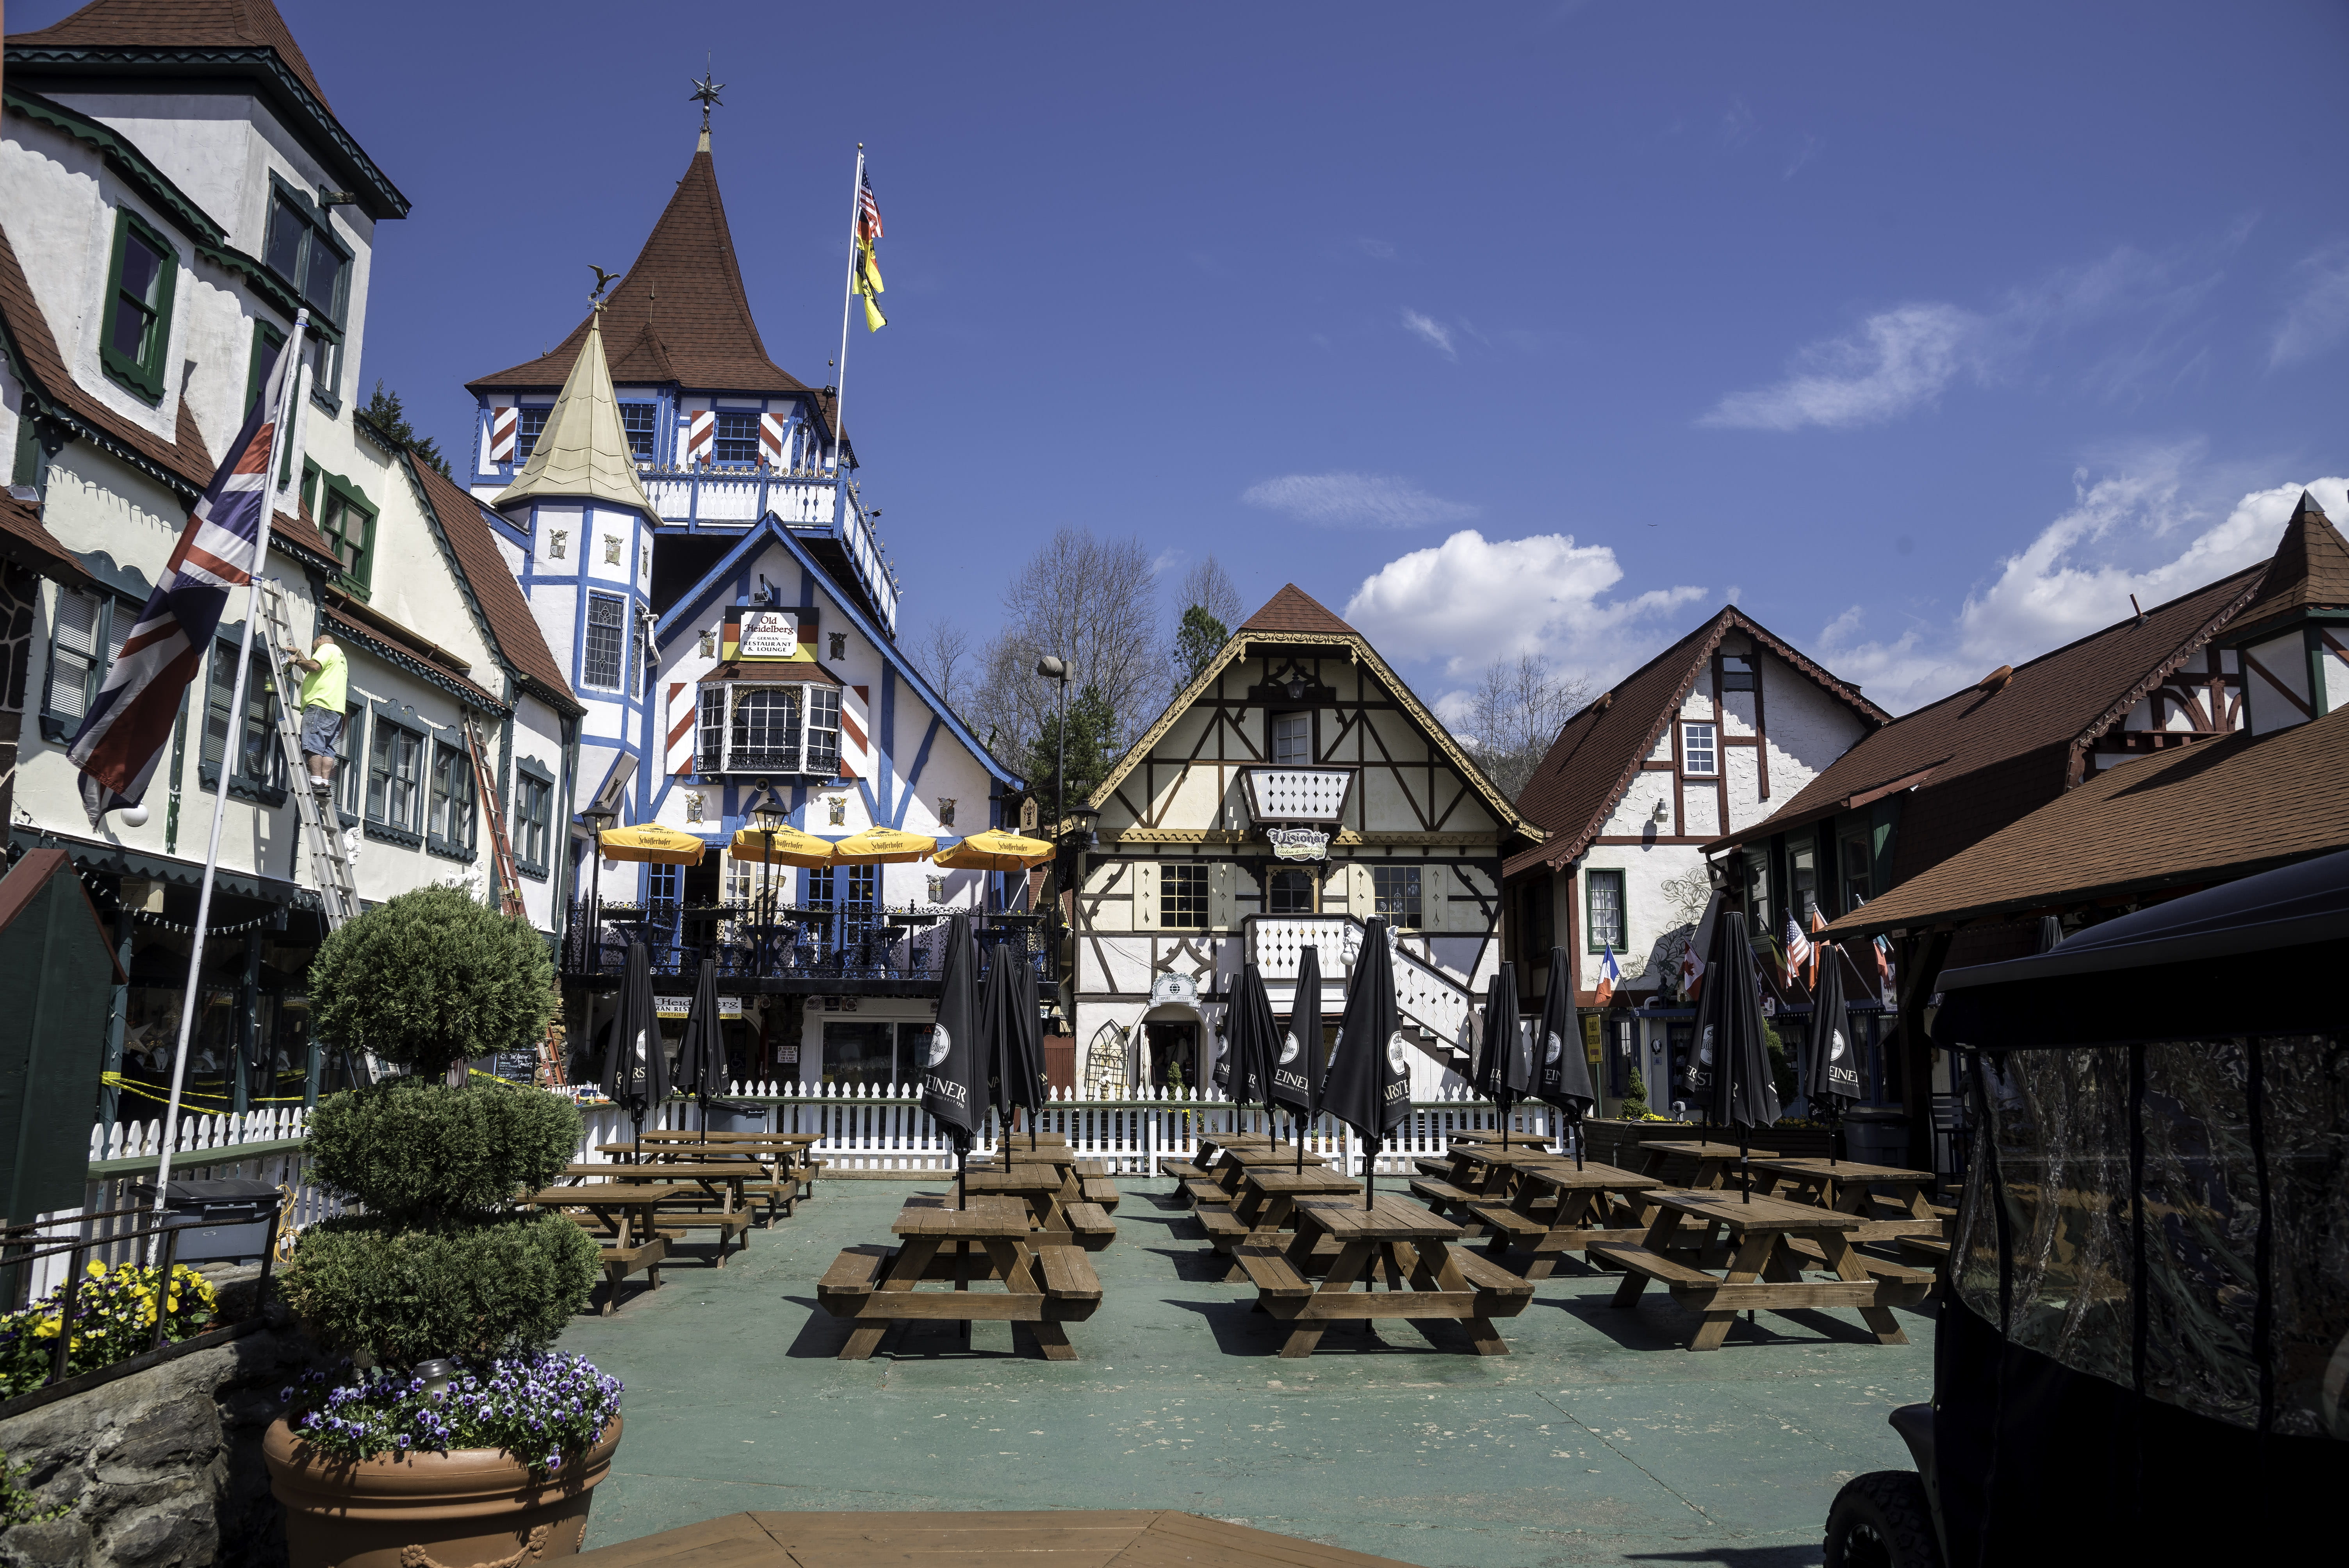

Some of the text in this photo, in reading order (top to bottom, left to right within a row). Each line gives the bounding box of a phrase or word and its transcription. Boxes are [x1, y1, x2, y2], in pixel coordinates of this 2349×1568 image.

[743, 624, 794, 634] Heidelberg
[638, 835, 672, 846] Schöfferhofer
[1267, 829, 1329, 845] Visionär
[771, 836, 803, 850] Schöfferhofer
[871, 841, 904, 851] Schöfferhofer
[998, 841, 1028, 852] Schöfferhofer
